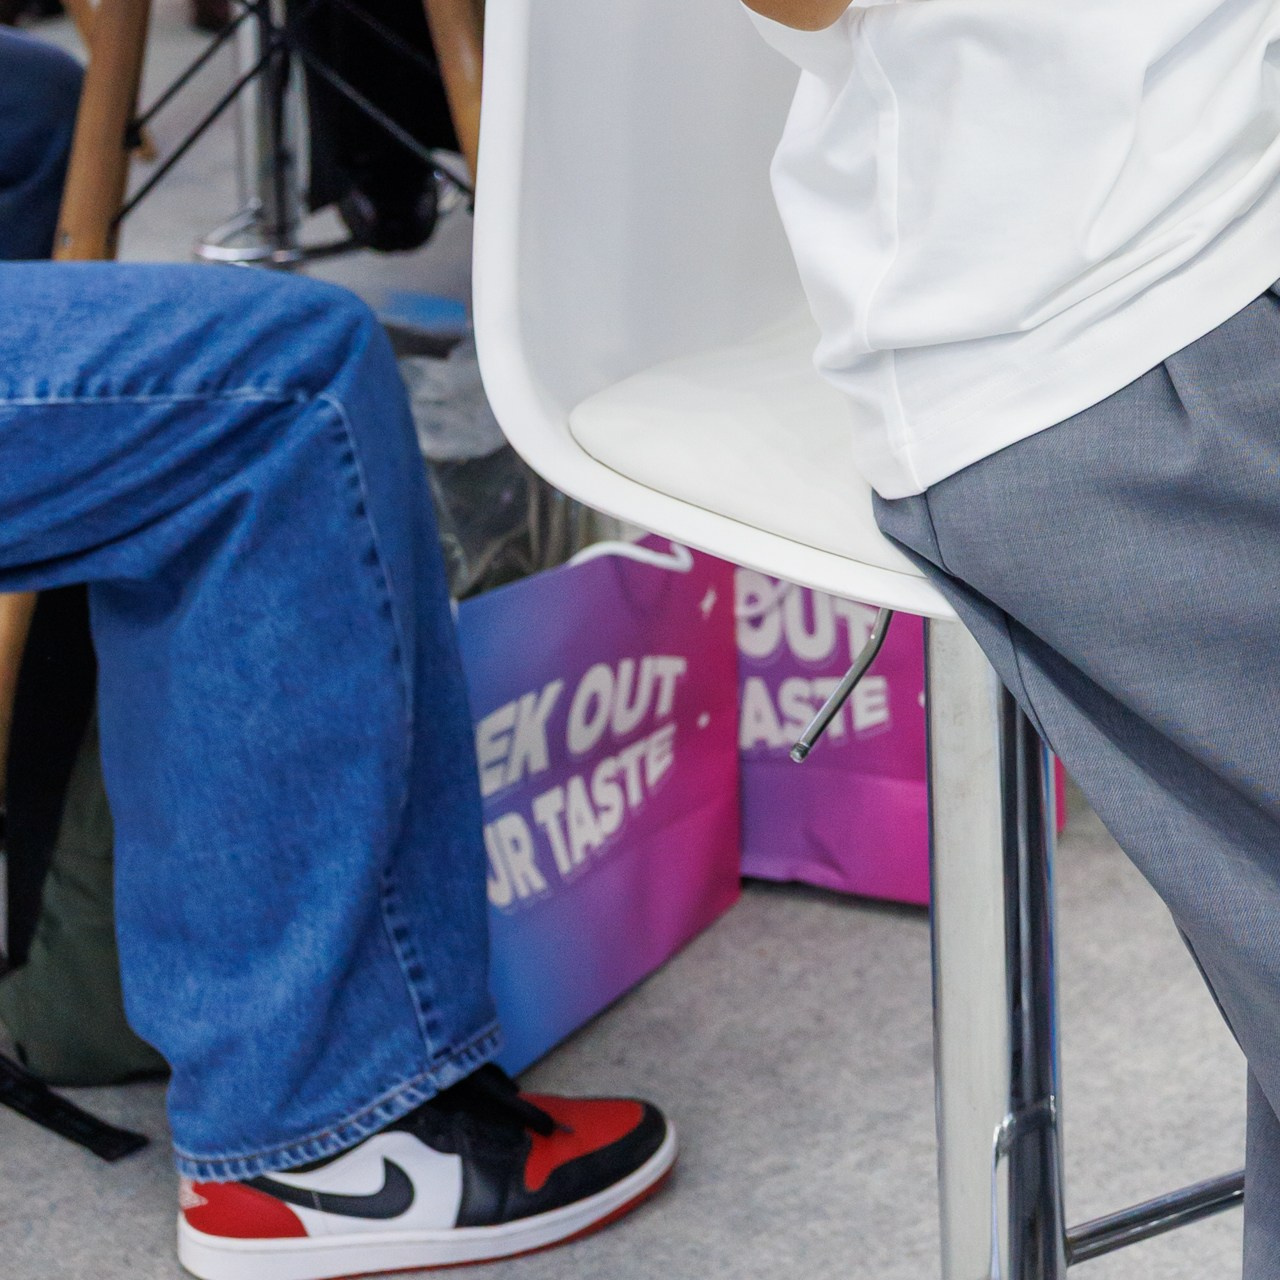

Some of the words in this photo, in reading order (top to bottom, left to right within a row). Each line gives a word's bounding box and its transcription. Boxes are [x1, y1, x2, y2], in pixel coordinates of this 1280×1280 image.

[476, 678, 565, 798] EK
[566, 656, 687, 755] OUT
[739, 676, 890, 750] ASTE
[532, 723, 677, 875] TASTE
